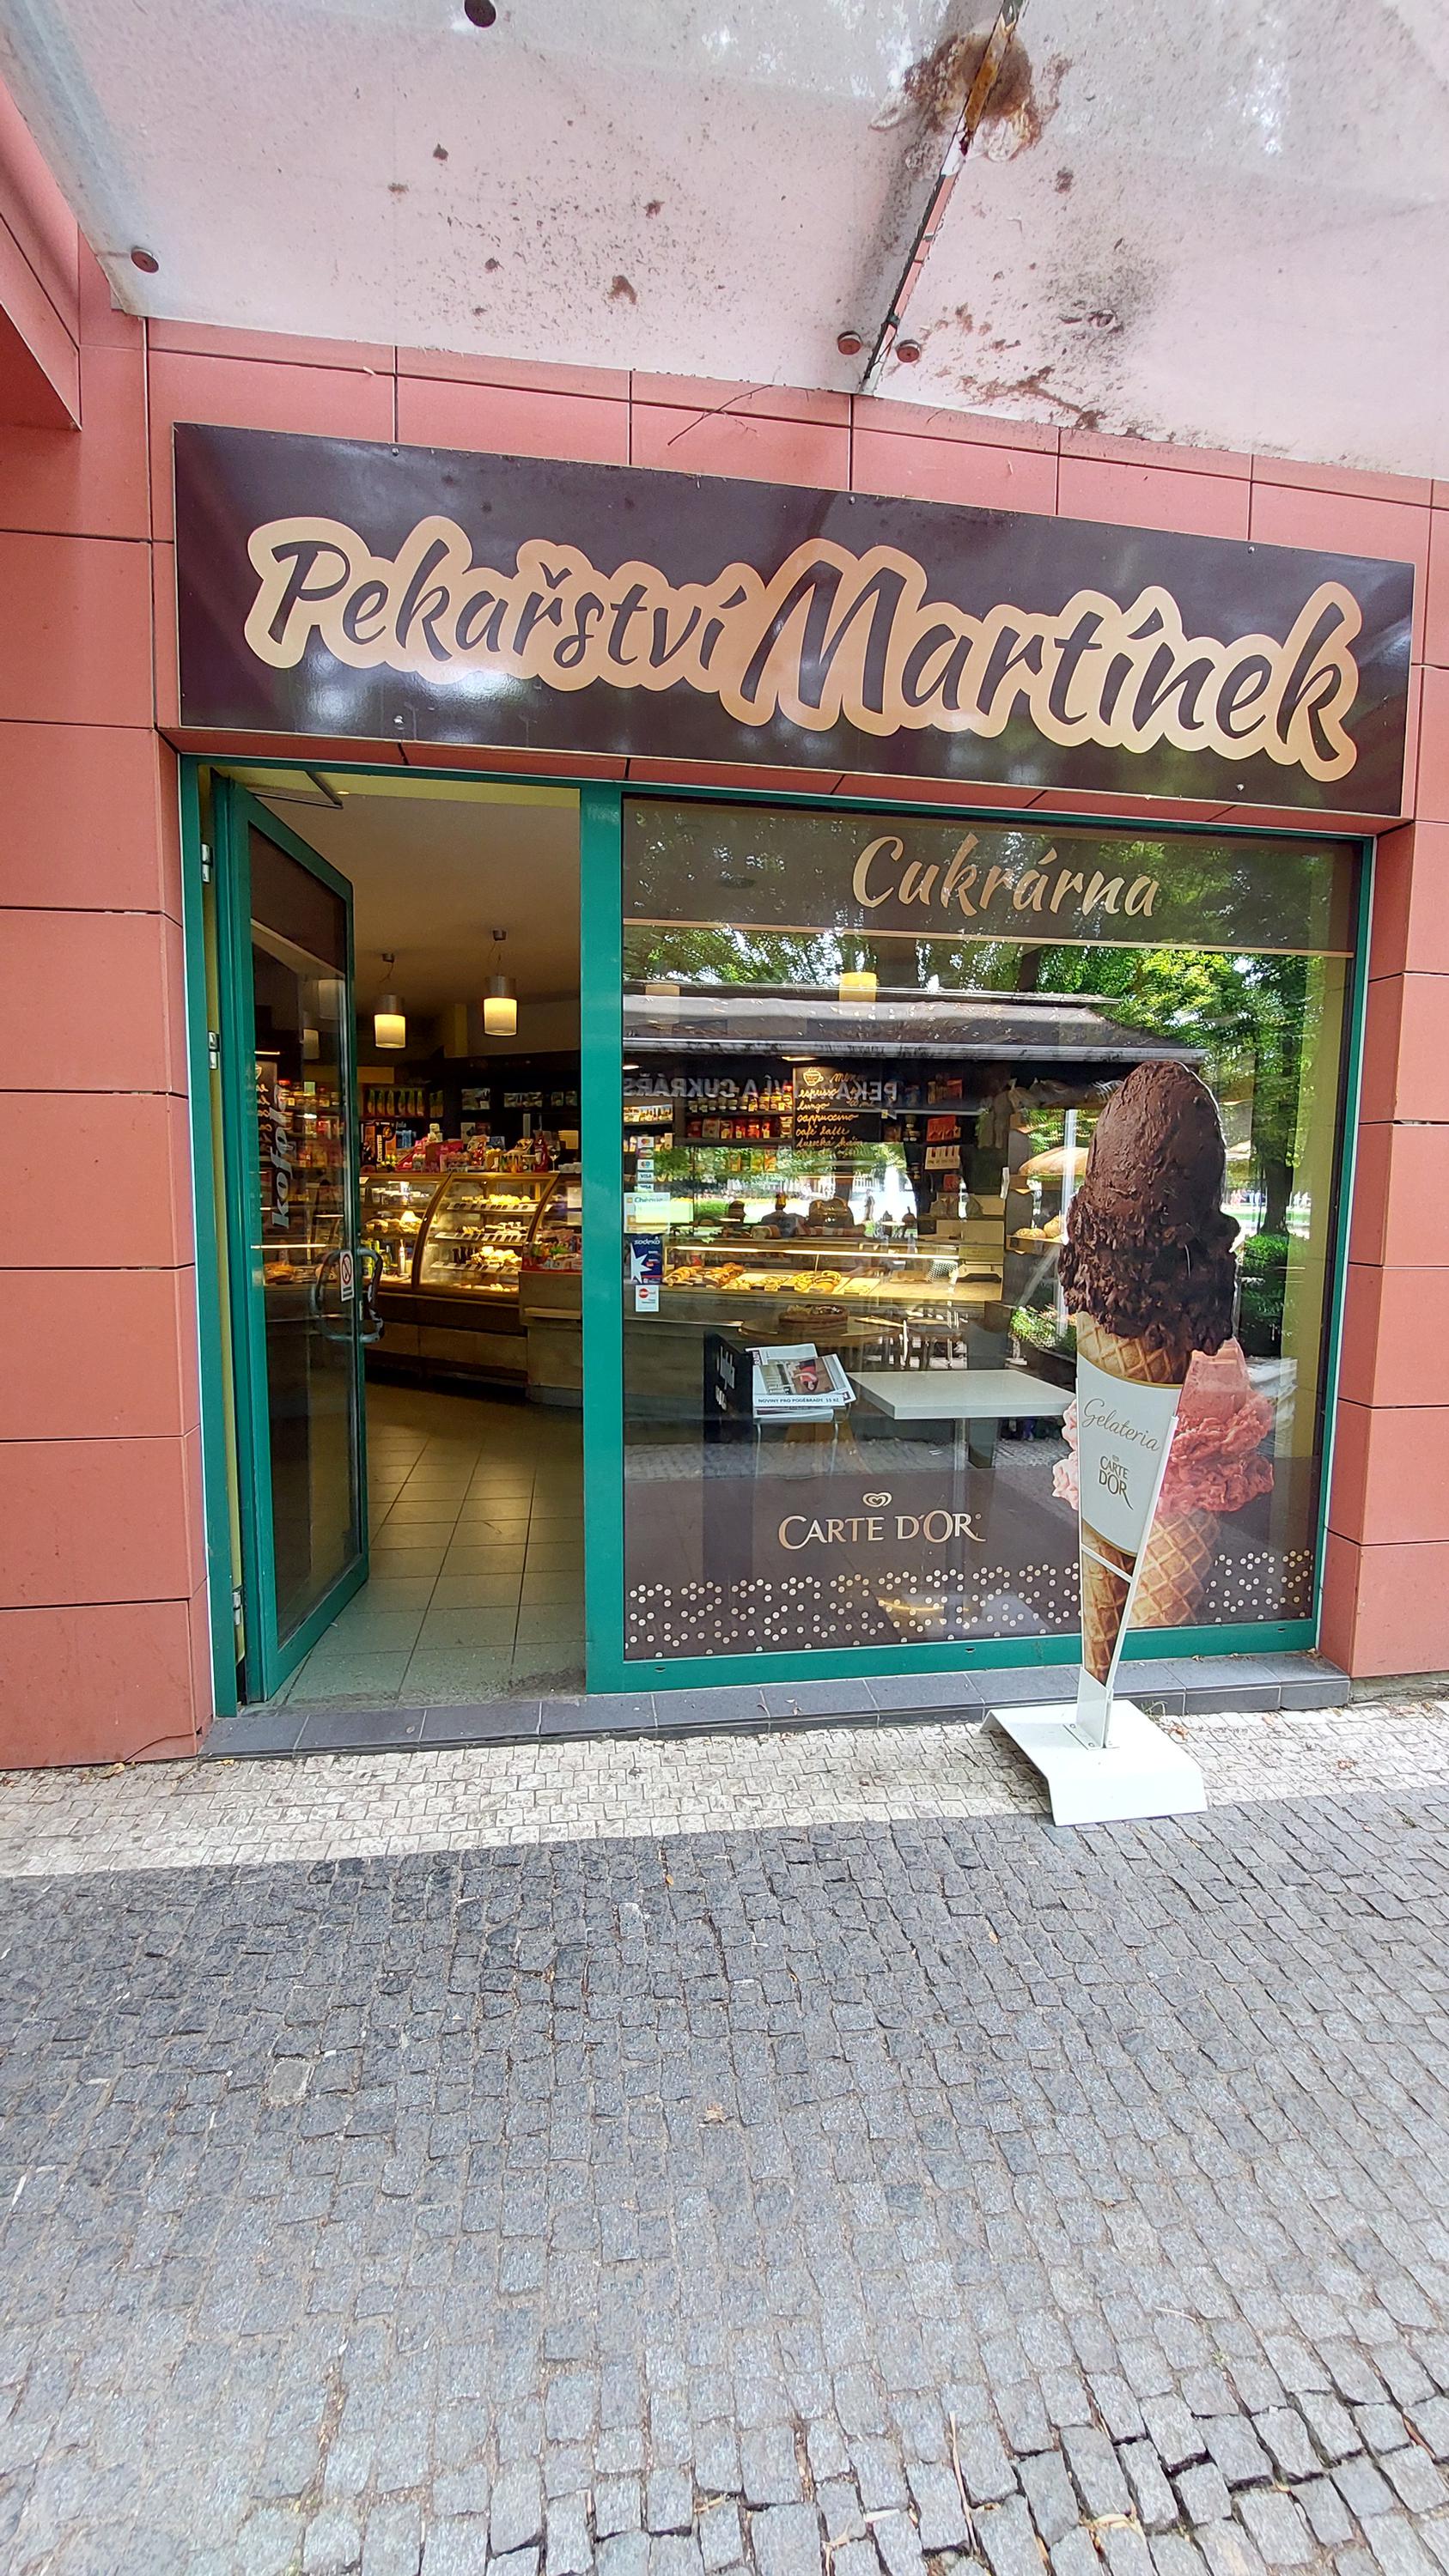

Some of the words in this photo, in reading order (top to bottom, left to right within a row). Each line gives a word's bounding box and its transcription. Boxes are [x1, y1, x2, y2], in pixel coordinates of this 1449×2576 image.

[267, 538, 748, 670] Pekařství
[740, 560, 1346, 762] Martínek
[853, 832, 1160, 917] Cukrárna
[796, 1101, 830, 1113] lungo
[1082, 1398, 1160, 1452] Gelateria
[1099, 1455, 1129, 1480] CARTE
[1099, 1469, 1134, 1511] D'OR
[778, 1516, 885, 1550] CARTE
